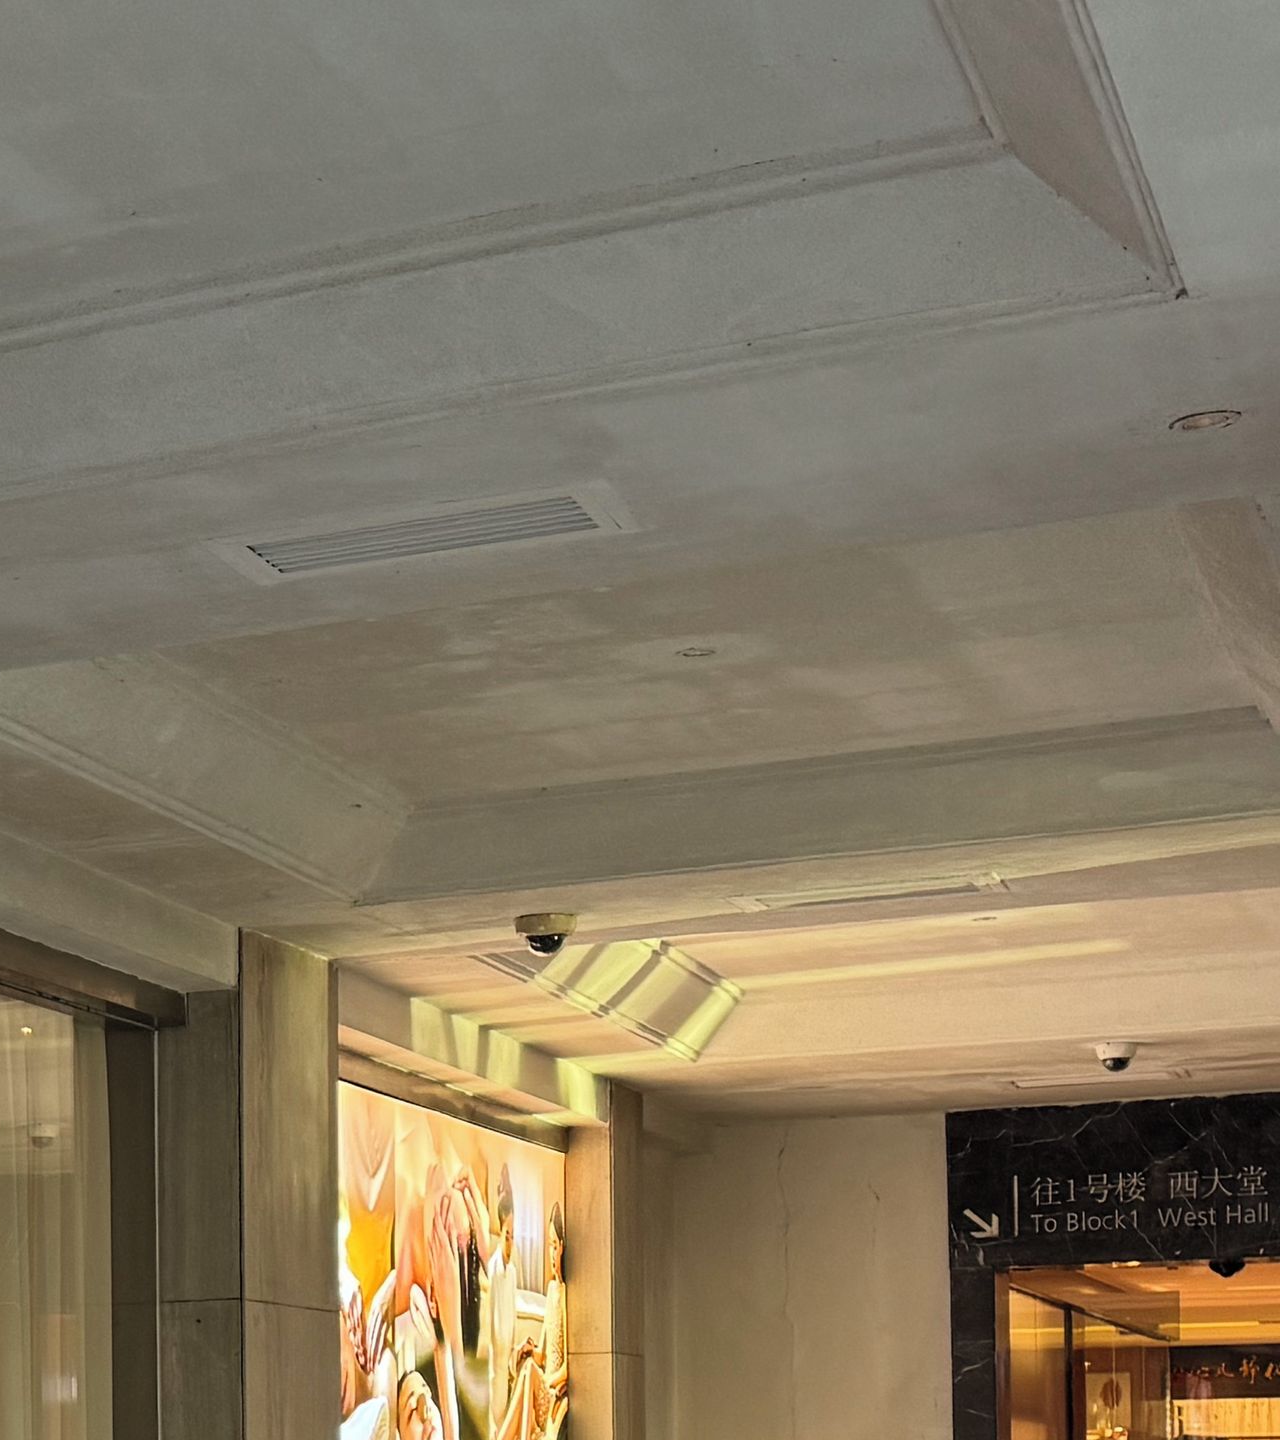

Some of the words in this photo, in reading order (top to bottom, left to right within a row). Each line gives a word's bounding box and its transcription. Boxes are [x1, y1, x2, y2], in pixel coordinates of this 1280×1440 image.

[1030, 1171, 1146, 1207] 往1号楼
[1168, 1165, 1269, 1200] 西大堂
[1030, 1213, 1057, 1234] To
[1157, 1205, 1217, 1229] West
[1225, 1201, 1269, 1225] Hall
